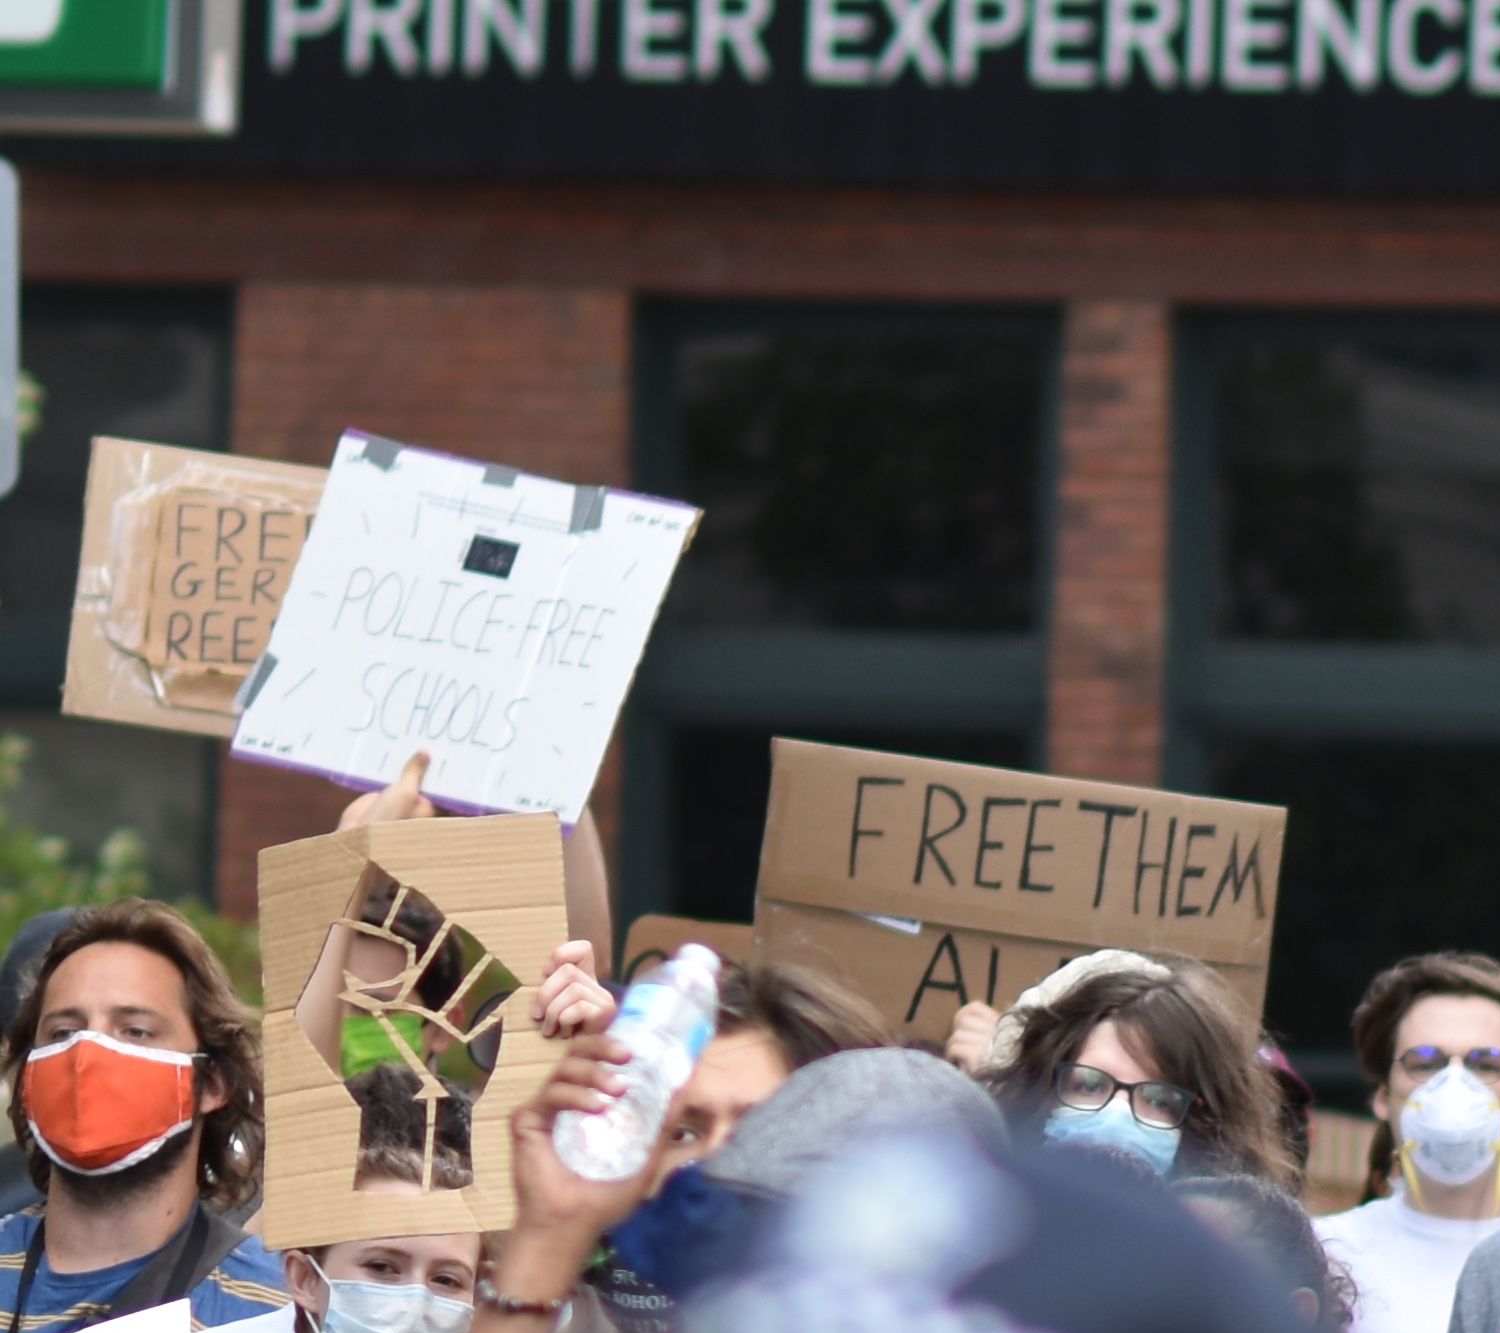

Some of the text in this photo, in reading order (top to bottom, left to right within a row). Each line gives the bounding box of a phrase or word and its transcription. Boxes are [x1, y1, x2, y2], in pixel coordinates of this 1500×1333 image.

[268, 0, 772, 84] PRINTER
[174, 503, 316, 564] FRE
[170, 562, 280, 603] GER
[332, 566, 616, 669] POLICE-FREE
[165, 611, 276, 664] REE
[349, 661, 530, 752] SCHOOLS
[849, 776, 1266, 921] FREE THEM
